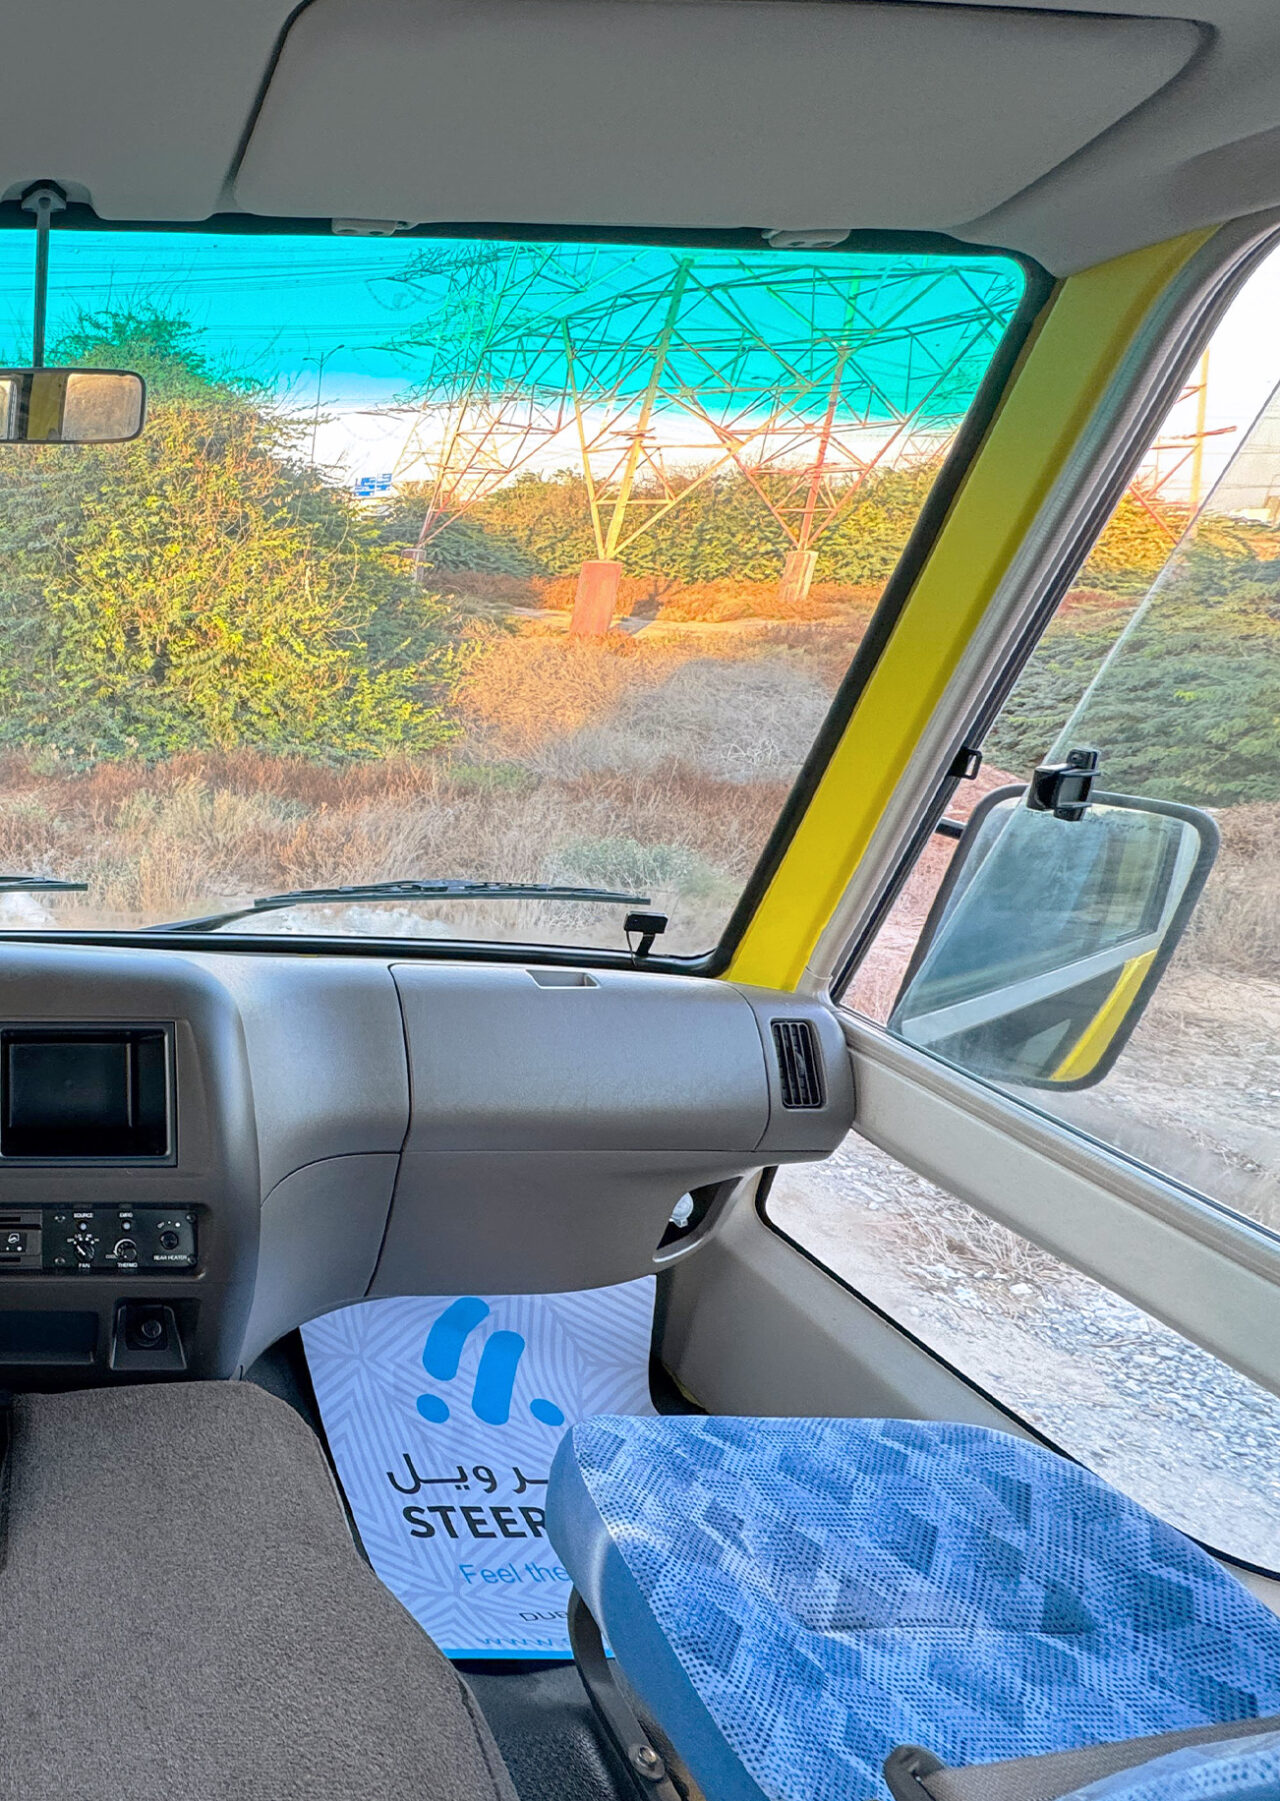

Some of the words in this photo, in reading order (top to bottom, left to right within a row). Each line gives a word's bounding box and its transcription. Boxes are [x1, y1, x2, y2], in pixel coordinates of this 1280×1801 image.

[402, 1505, 546, 1539] STEER
[458, 1562, 523, 1585] Feel
[524, 1562, 570, 1583] the
[518, 1611, 569, 1622] DUB
